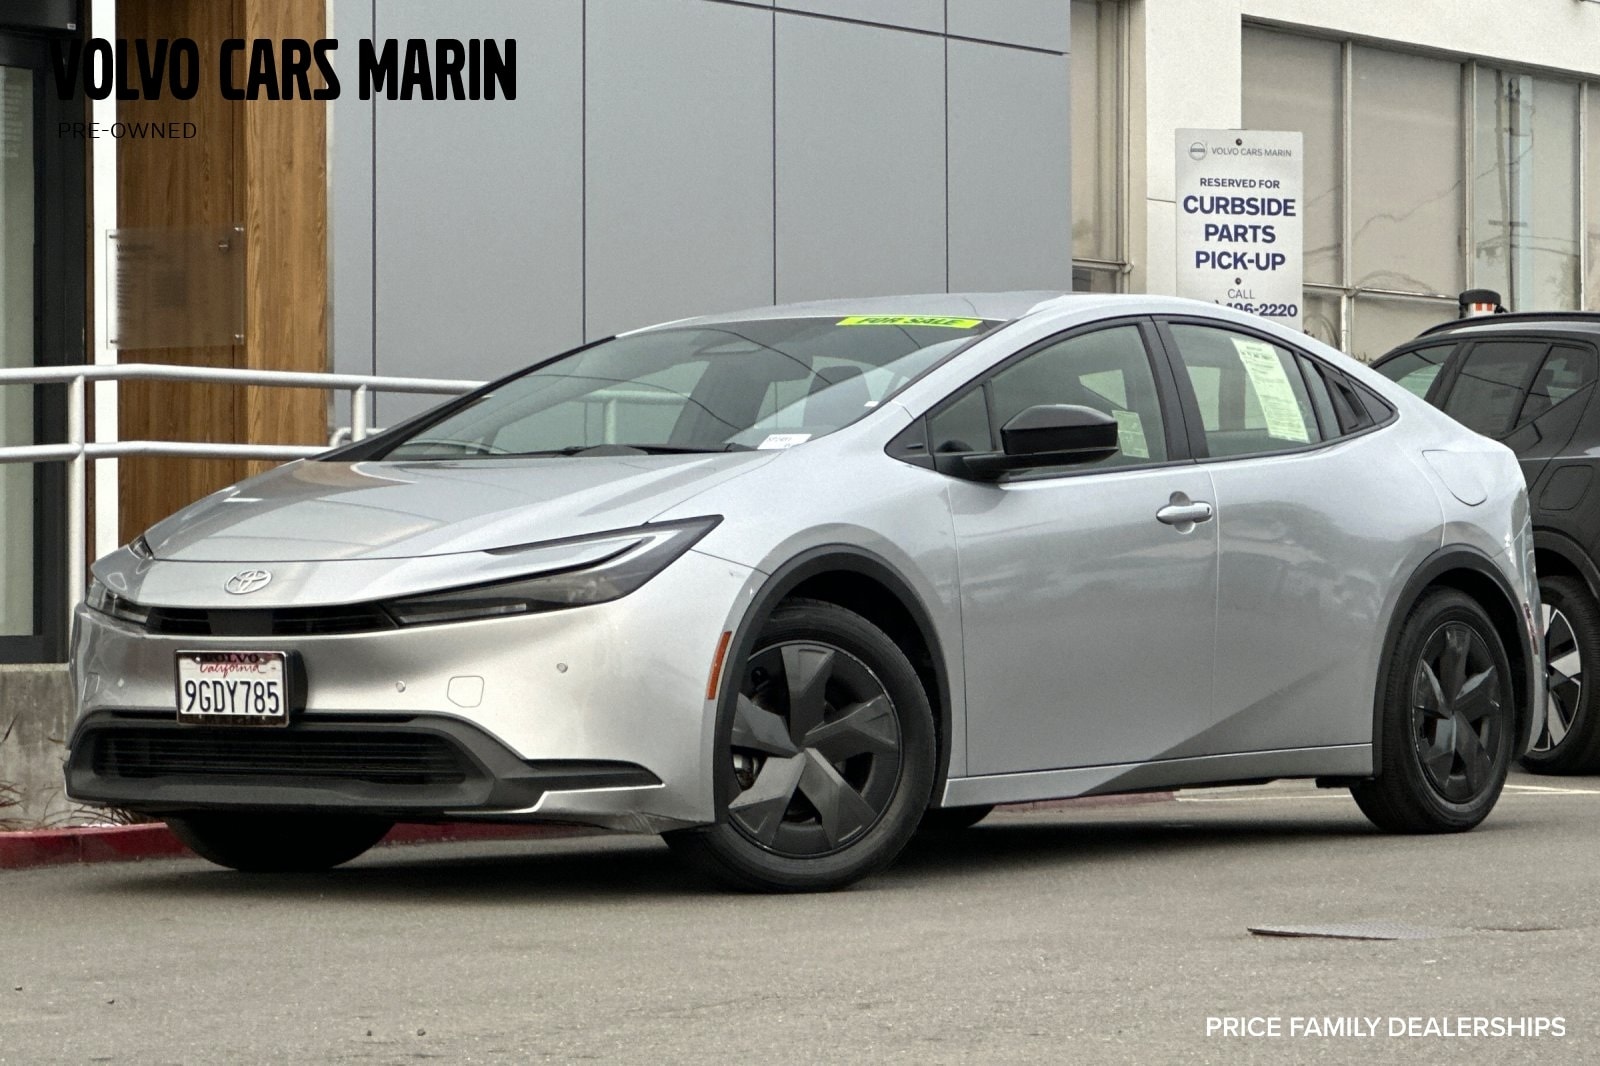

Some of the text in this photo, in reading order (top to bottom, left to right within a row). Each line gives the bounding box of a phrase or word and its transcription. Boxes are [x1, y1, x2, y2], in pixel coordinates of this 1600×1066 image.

[1211, 147, 1240, 156] VOLVO
[1240, 148, 1263, 157] CARS
[1264, 149, 1292, 158] MARIN
[1200, 178, 1281, 190] RESERVED FOR
[1183, 195, 1296, 217] CURBSIDE
[1204, 223, 1276, 243] PARTS
[1195, 250, 1286, 271] PICK-UP
[1227, 288, 1256, 300] CALL
[856, 316, 961, 326] FOR SALE
[185, 680, 280, 714] 9GDY785
